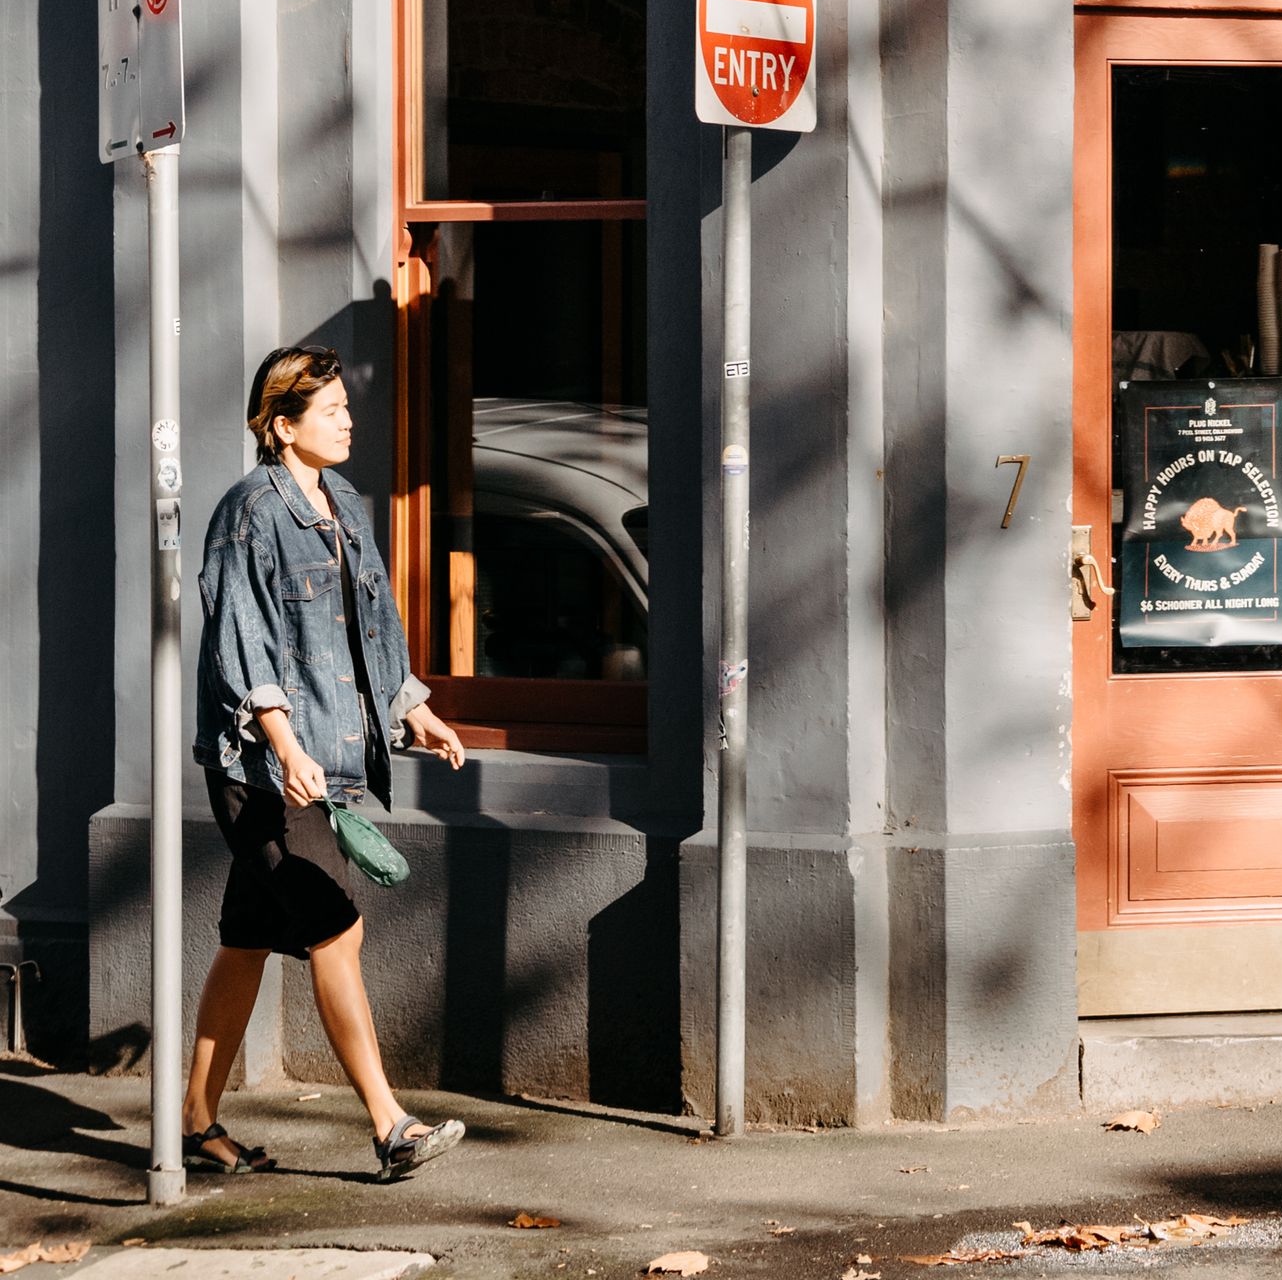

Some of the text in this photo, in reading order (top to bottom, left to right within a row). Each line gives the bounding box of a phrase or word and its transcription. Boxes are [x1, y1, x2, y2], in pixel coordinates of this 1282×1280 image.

[714, 46, 797, 92] ENTRY
[1188, 419, 1232, 428] PLUG NICKEL
[995, 454, 1032, 529] 7
[1143, 450, 1279, 530] HAPPY HOURS ON TAP SELECTION
[1153, 552, 1265, 592] EVERY THURS & SUNDAY
[1140, 597, 1280, 613] $6 SCHOONER ALL NIGHT LONG
